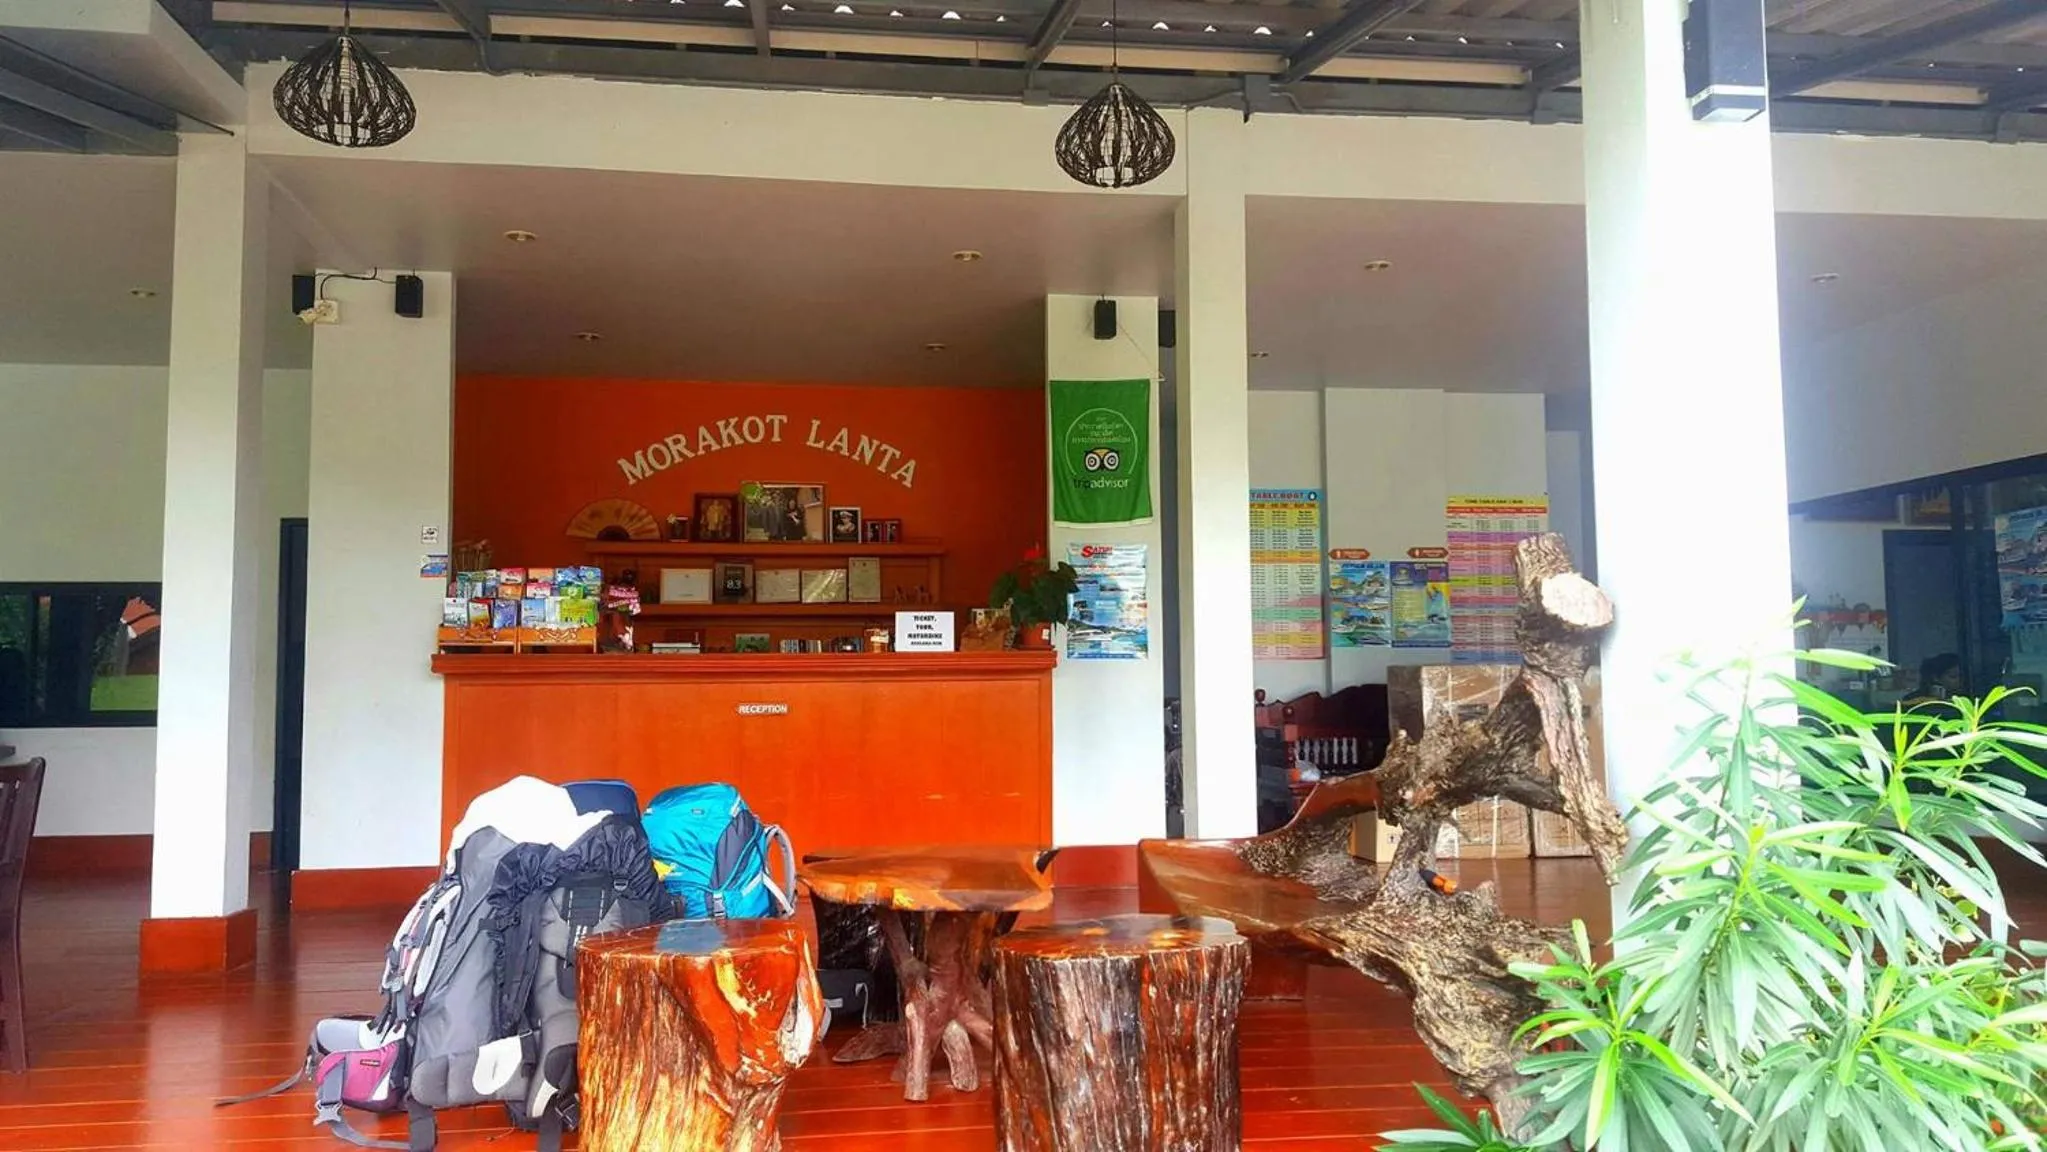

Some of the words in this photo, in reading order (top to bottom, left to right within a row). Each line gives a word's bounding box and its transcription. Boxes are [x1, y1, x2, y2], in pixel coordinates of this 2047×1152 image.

[617, 414, 788, 486] MORAKOT
[805, 418, 918, 489] LANTA
[738, 703, 788, 714] RECEPTION
